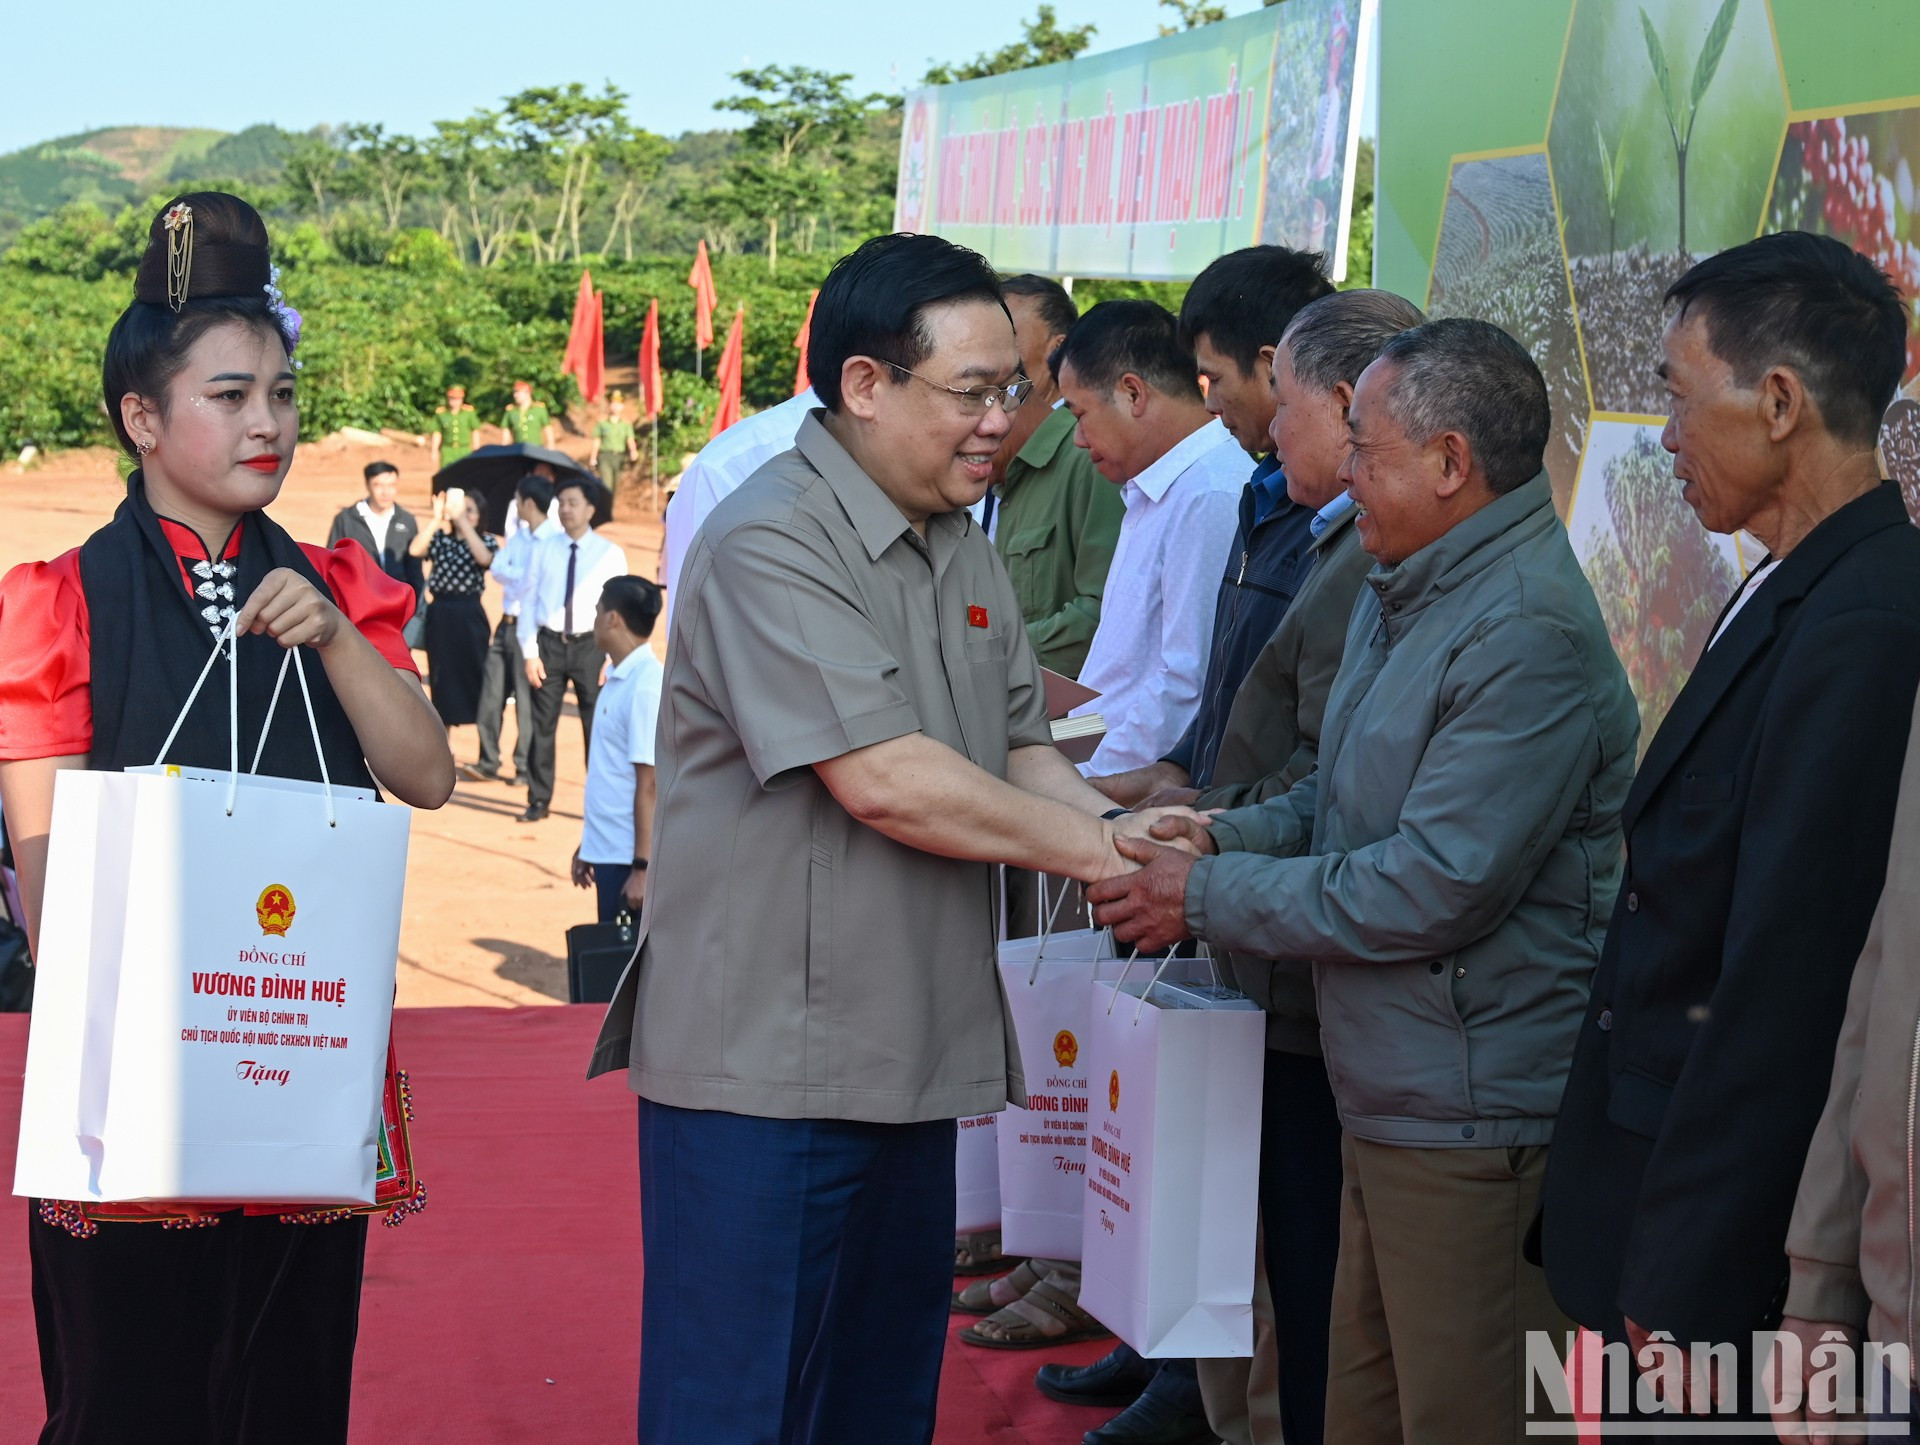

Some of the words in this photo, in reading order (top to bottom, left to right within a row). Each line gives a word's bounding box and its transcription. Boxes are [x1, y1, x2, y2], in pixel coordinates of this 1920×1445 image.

[1155, 98, 1200, 250] MẠO
[1196, 64, 1241, 222] MỚI
[238, 945, 279, 965] ĐỒNG
[281, 952, 306, 967] CHÍ
[192, 971, 256, 997] VƯƠNG
[261, 973, 306, 1001] ĐÌNH
[311, 978, 347, 1008] HUỆ
[227, 1005, 238, 1022] ỦY
[239, 1008, 257, 1023] VIÊN
[259, 1009, 270, 1026] BỘ
[271, 1009, 295, 1025] CHÍNH
[296, 1013, 309, 1028] TRỊ
[181, 1025, 199, 1042] CHỦ
[200, 1029, 218, 1046] TỊCH
[219, 1027, 241, 1044] QUỐC
[242, 1030, 256, 1047] HỘI
[257, 1030, 279, 1046] NƯỚC
[280, 1034, 311, 1048] CHXHCN
[312, 1033, 329, 1051] VIỆT
[330, 1036, 348, 1049] NAM
[235, 1060, 291, 1086] Tặng
[1046, 1075, 1071, 1088] ĐỒNG
[1072, 1077, 1087, 1089] CHÍ
[1025, 1094, 1059, 1112] ƯƠNG
[1061, 1093, 1088, 1113] ĐÌNH
[959, 1119, 975, 1131] TỊCH
[975, 1114, 995, 1127] QUỐC
[1050, 1118, 1061, 1130] VIÊN
[1069, 1119, 1085, 1131] CHÍNH
[1052, 1156, 1086, 1175] Tặng
[1100, 1209, 1115, 1236] Tặng
